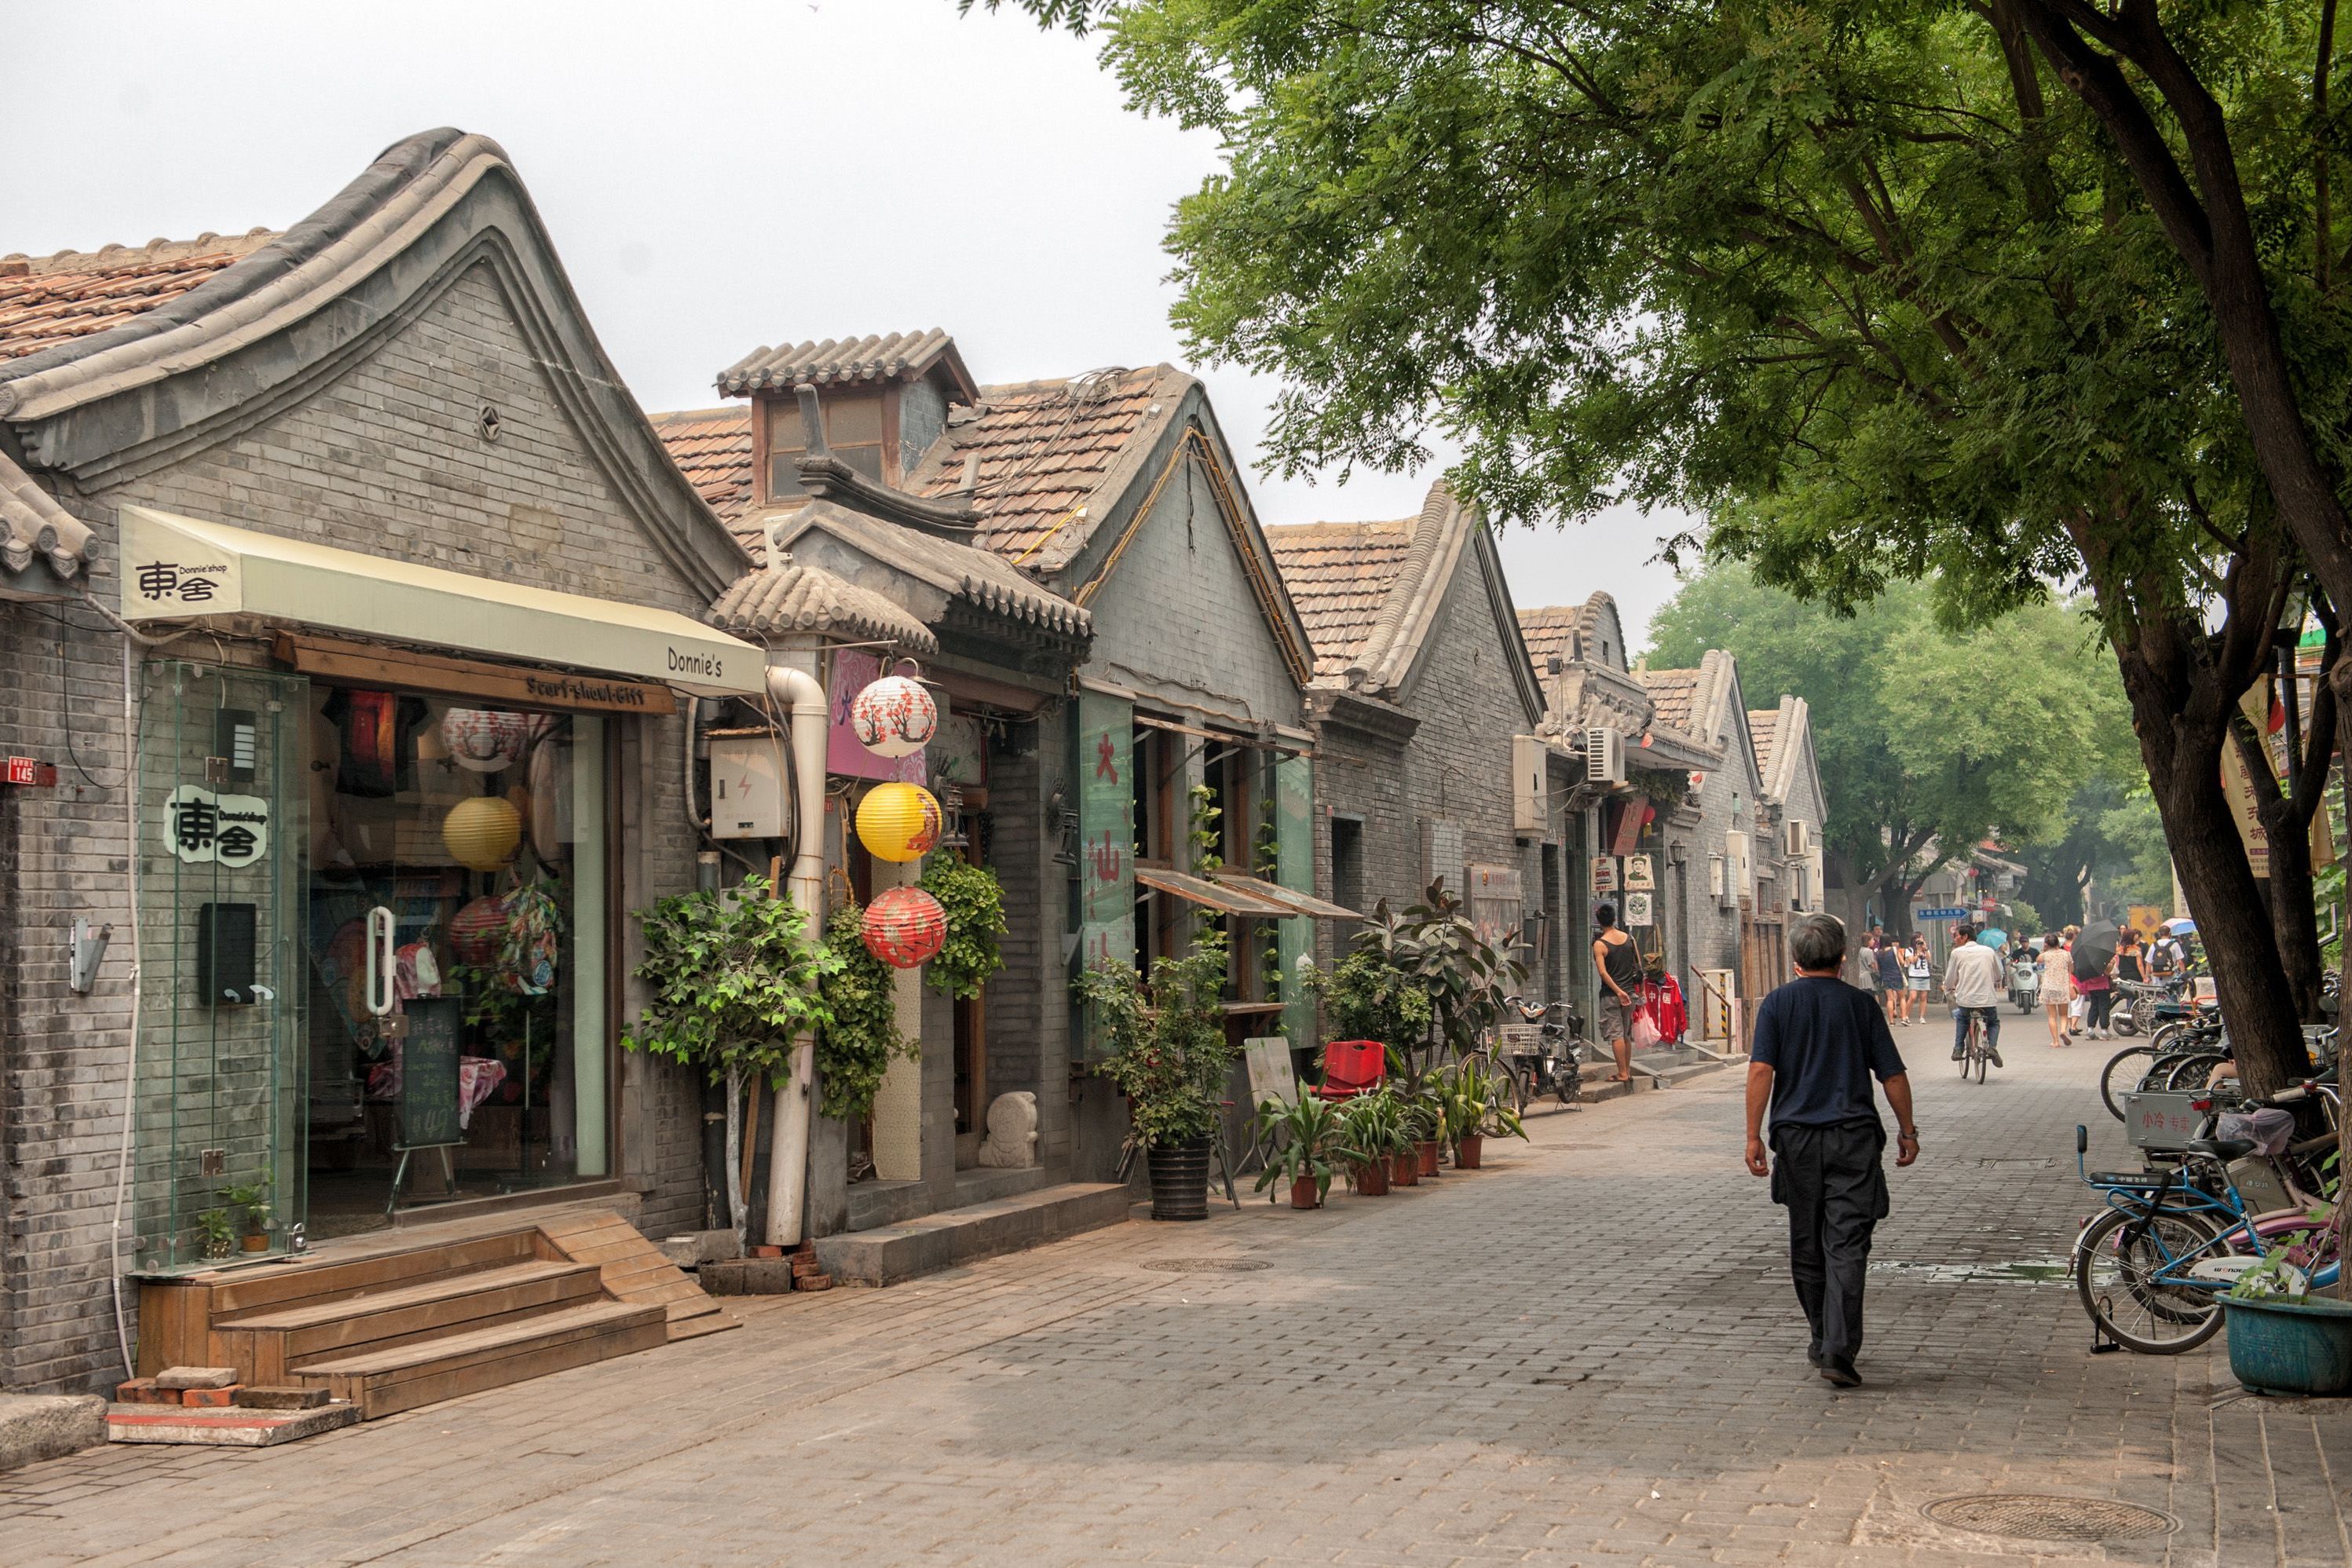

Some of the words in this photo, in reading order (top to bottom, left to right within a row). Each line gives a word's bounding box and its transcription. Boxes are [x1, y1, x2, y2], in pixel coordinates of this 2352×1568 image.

[668, 645, 722, 678] Donnie's
[16, 766, 33, 782] 145
[1649, 991, 1671, 1004] 中国
